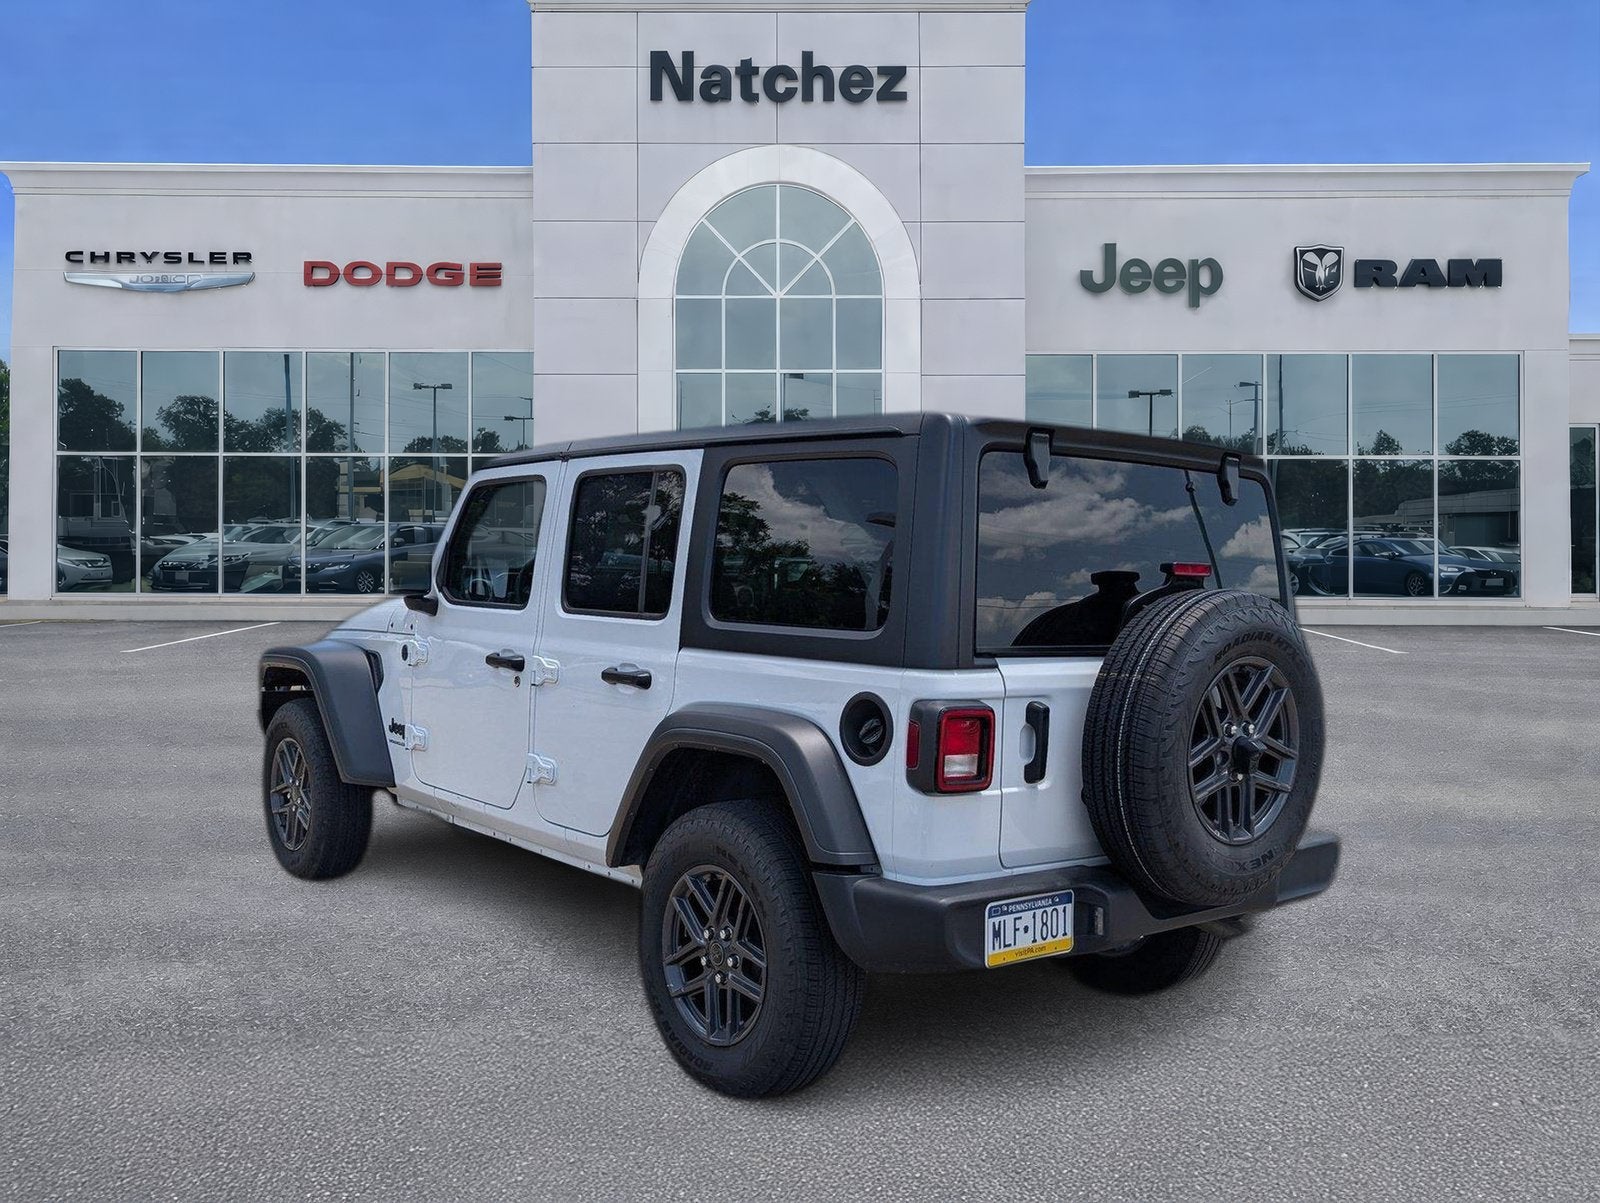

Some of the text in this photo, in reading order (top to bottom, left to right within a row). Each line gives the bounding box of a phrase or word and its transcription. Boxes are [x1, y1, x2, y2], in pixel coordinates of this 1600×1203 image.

[650, 51, 907, 102] Natchez
[65, 251, 253, 264] CHRYSLER
[303, 261, 502, 287] DODGE
[1080, 243, 1223, 309] Jeep
[1354, 258, 1502, 288] RAM
[1008, 898, 1053, 913] PENNSYLVANIA
